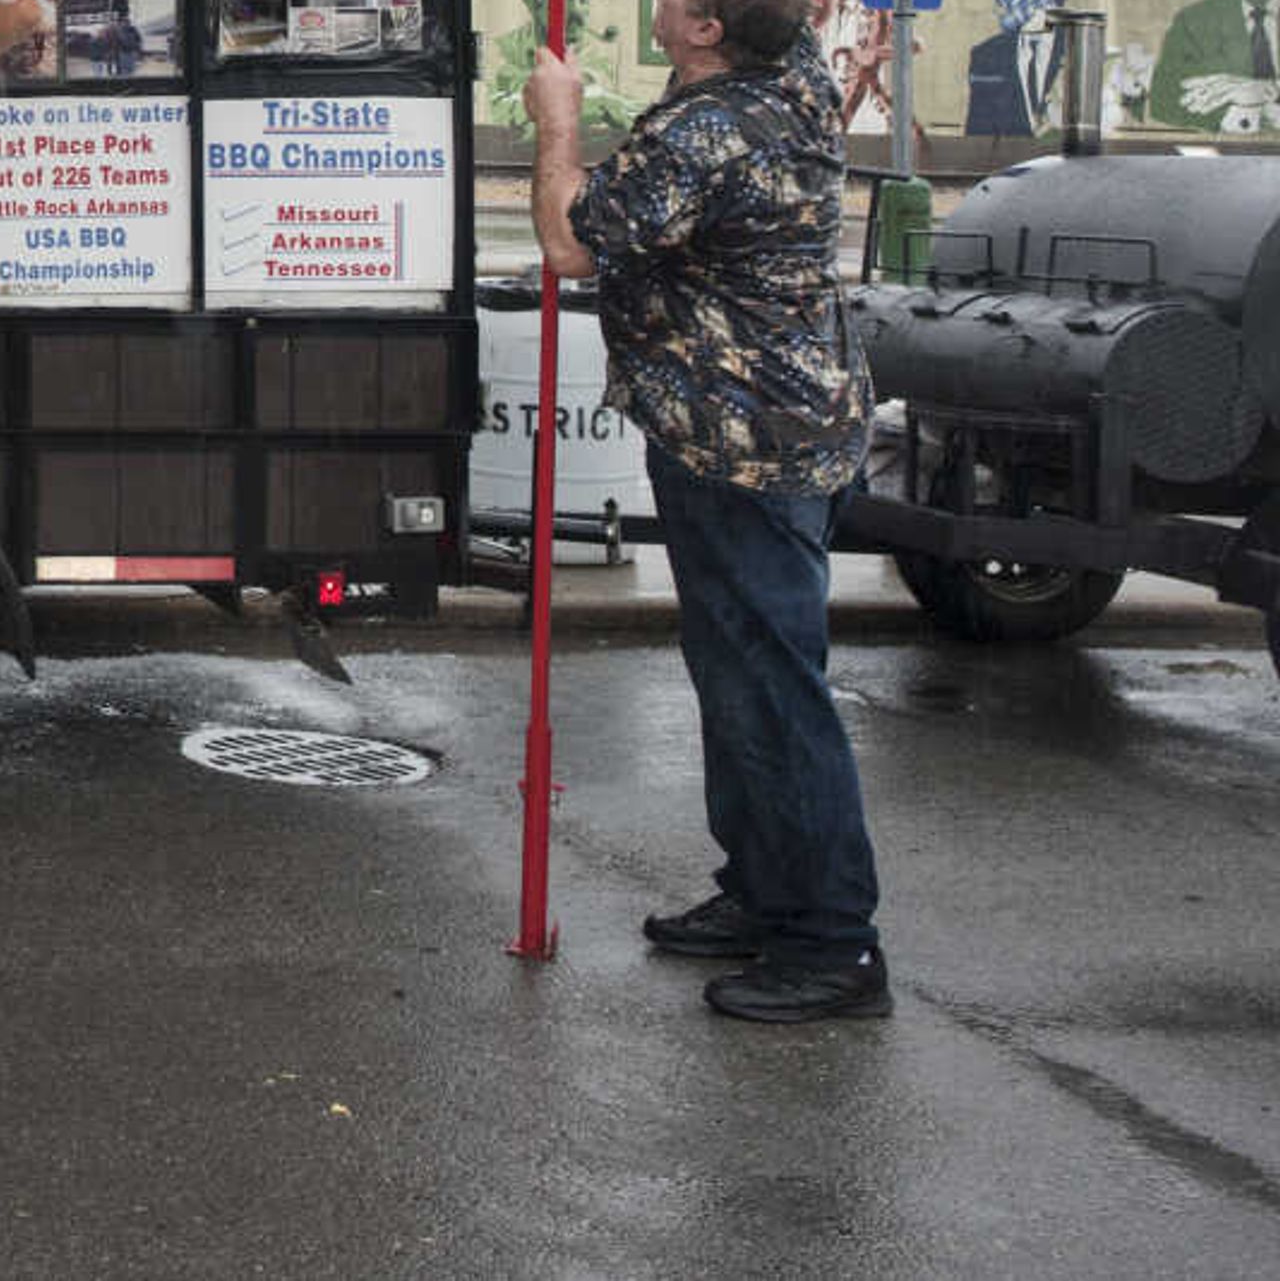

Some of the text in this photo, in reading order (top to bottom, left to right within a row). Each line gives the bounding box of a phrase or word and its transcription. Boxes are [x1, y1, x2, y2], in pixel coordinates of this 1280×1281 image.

[43, 107, 70, 124] on
[78, 103, 114, 123] the
[123, 104, 185, 123] water
[262, 101, 392, 129] Tri-State
[34, 136, 99, 155] Place
[103, 134, 153, 154] Pork
[207, 141, 446, 176] BBQ Champions
[22, 167, 43, 187] of
[100, 166, 170, 186] Teams
[34, 200, 78, 216] Rock
[86, 198, 169, 216] Arkansas
[276, 204, 380, 222] Missouri
[24, 228, 129, 250] USA BBQ
[271, 233, 385, 250] Arkansas
[263, 259, 392, 278] Tennessee
